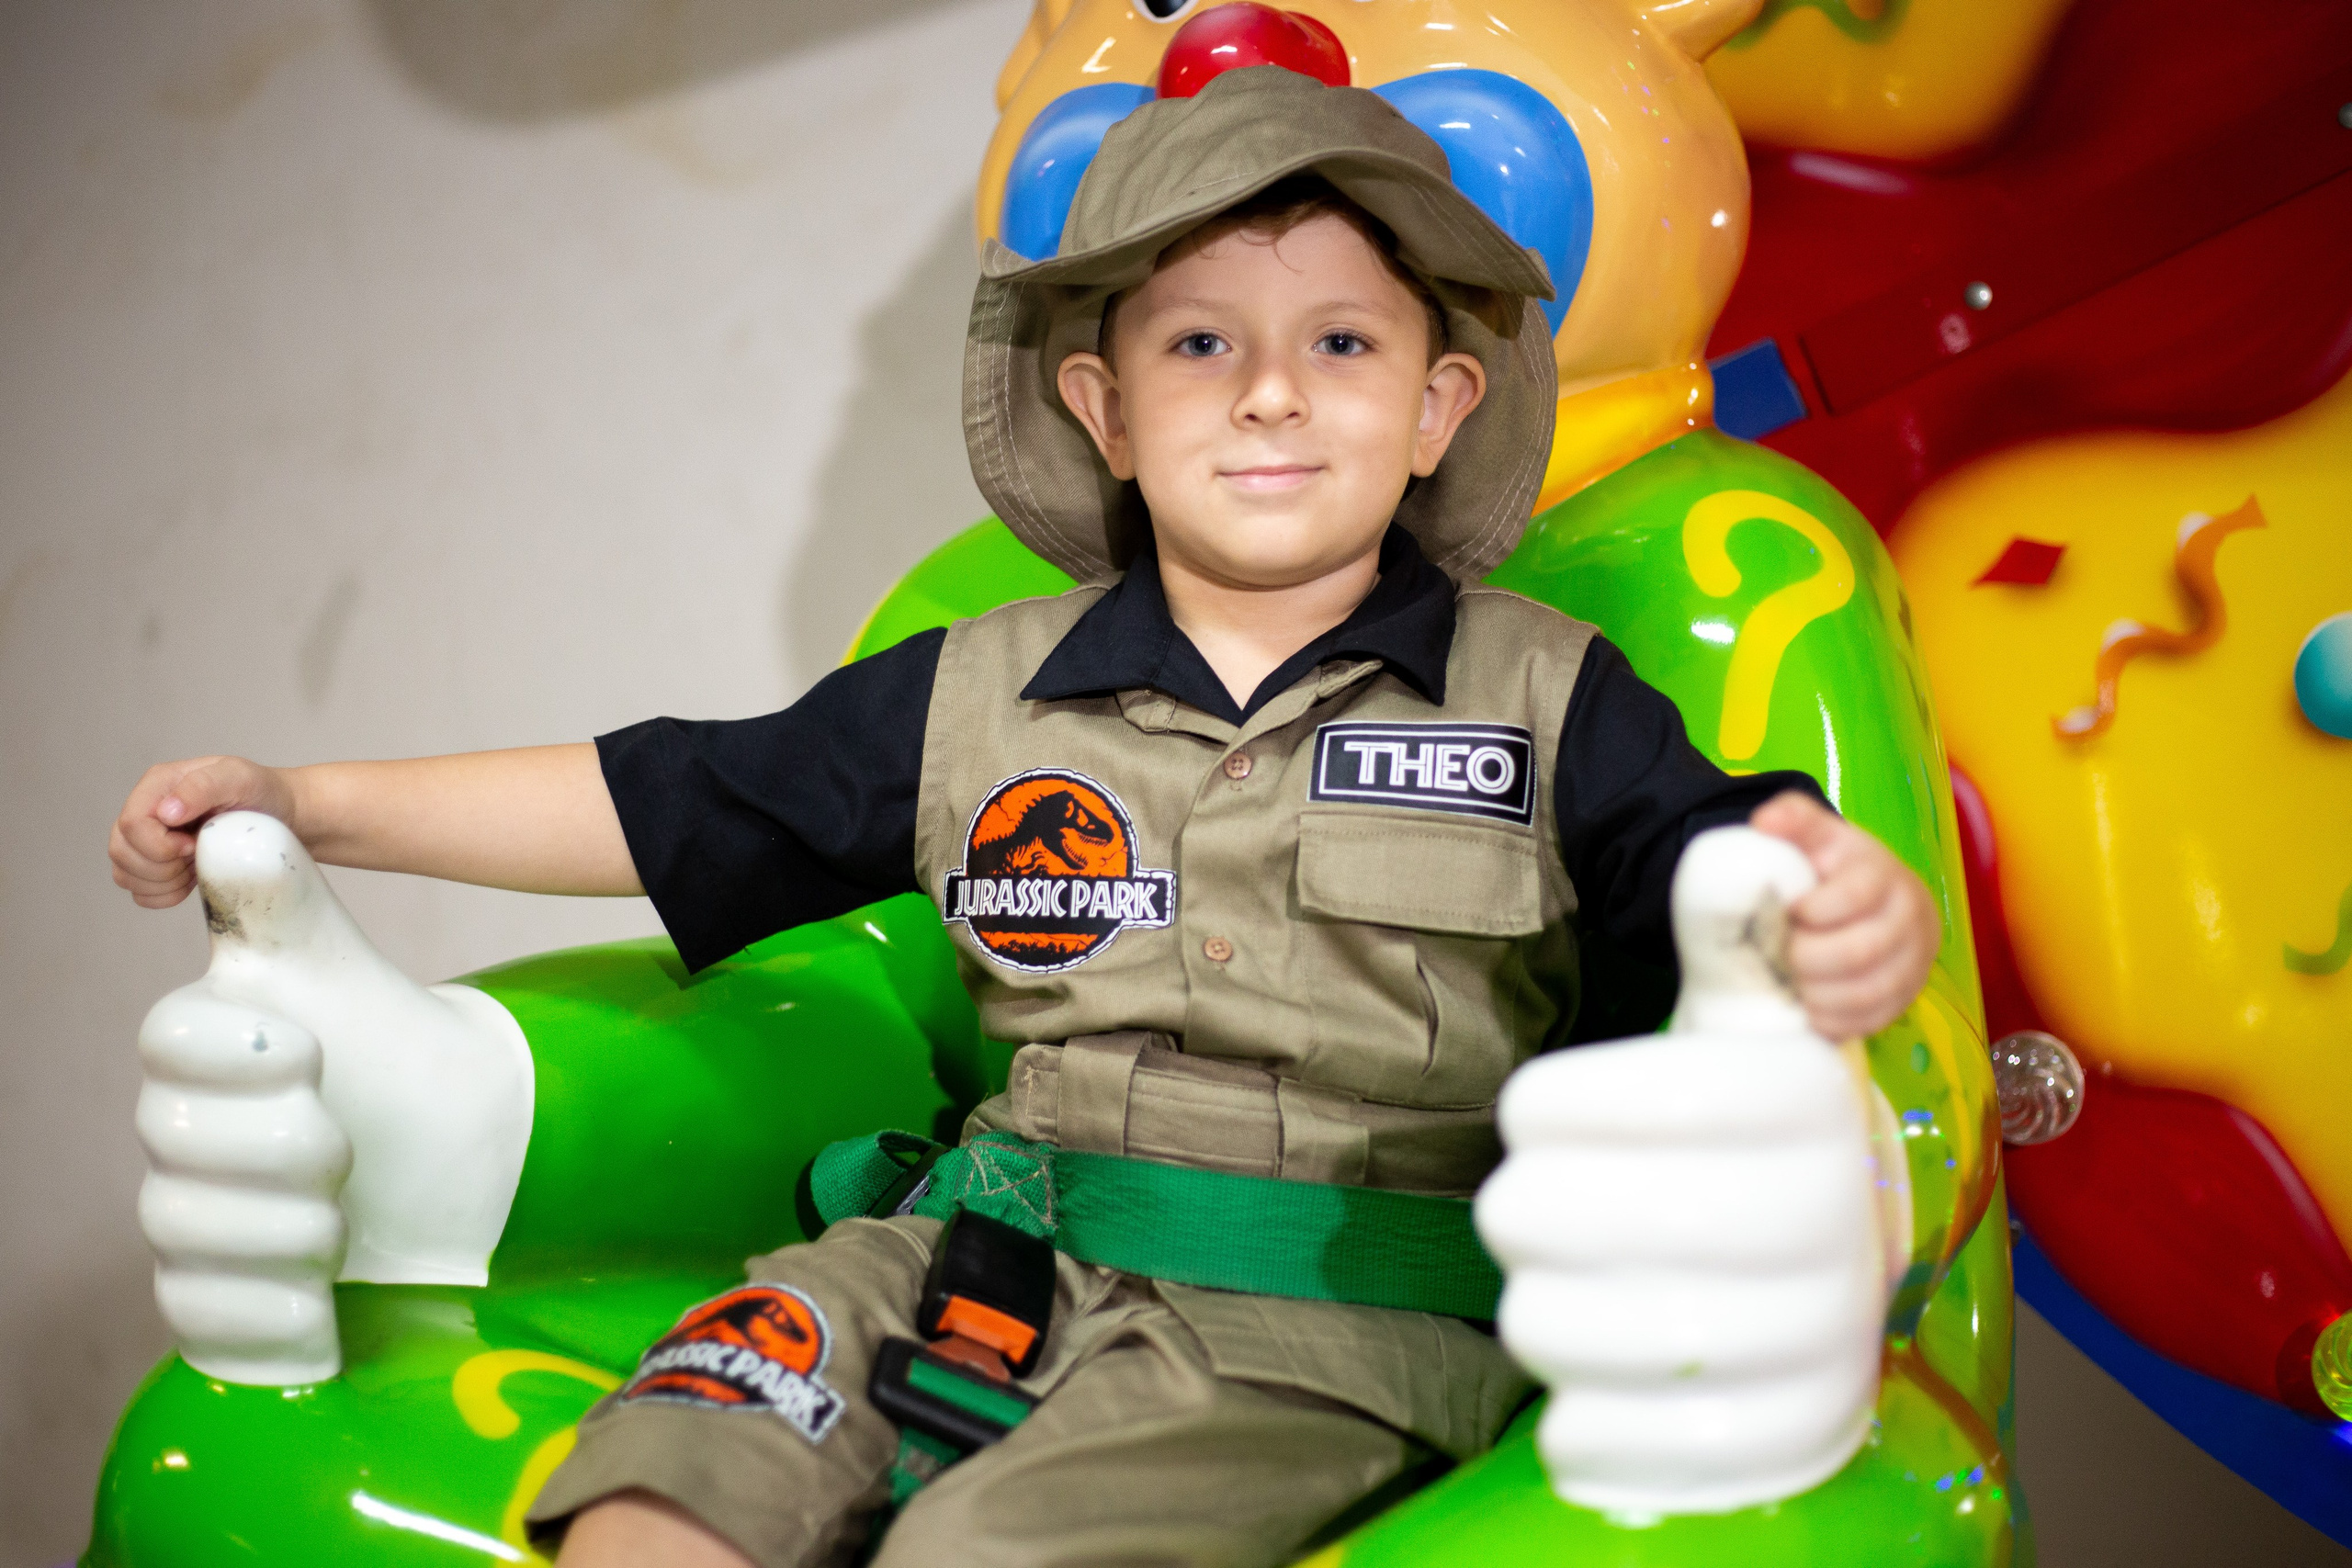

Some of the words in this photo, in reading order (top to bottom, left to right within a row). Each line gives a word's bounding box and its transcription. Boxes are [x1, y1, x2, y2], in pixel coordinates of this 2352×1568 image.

[1344, 740, 1515, 795] THEO
[954, 877, 1068, 917] JURASSIC
[1069, 879, 1158, 919] PARK
[725, 1348, 827, 1427] PARK
